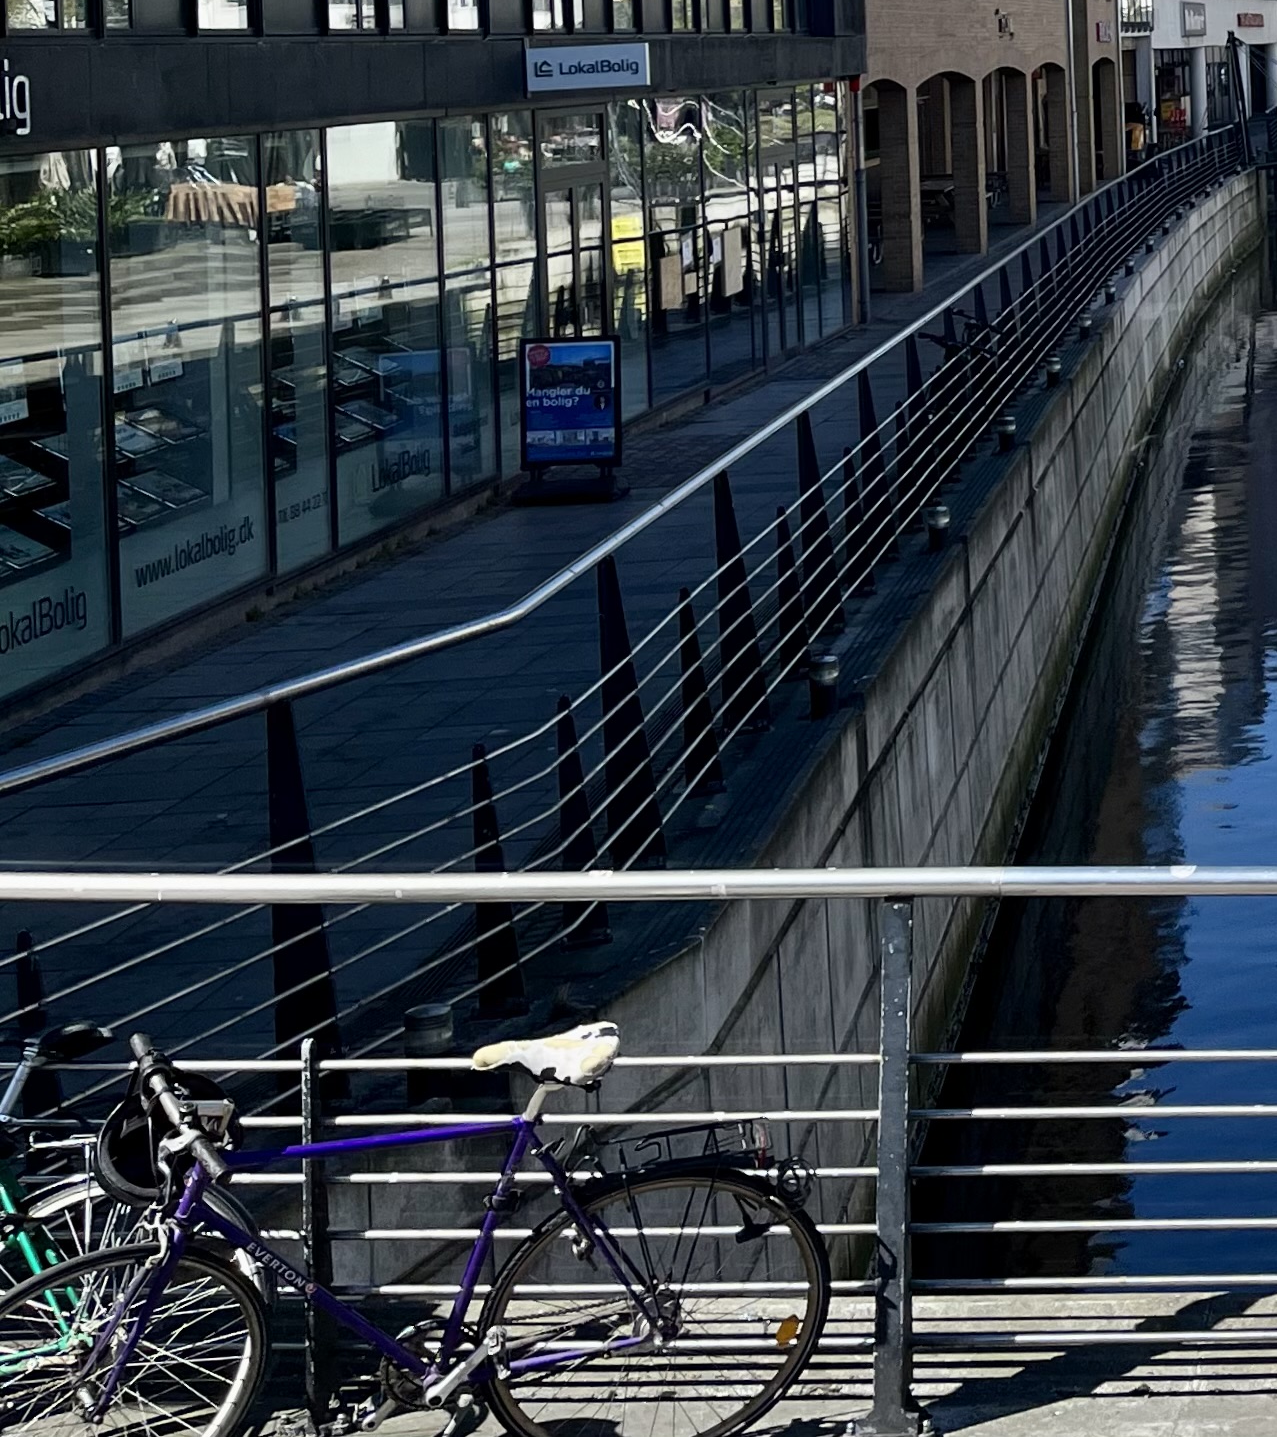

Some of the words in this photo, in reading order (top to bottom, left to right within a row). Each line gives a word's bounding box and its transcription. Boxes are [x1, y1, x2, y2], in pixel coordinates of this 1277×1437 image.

[559, 59, 640, 76] LokalBolig
[0, 58, 31, 136] ig
[526, 386, 572, 398] Mangler
[575, 385, 591, 396] du
[526, 398, 540, 407] en
[543, 396, 579, 408] bolig?
[134, 516, 255, 588] www.lokalbolig.dk
[246, 1242, 306, 1289] EVERTON
